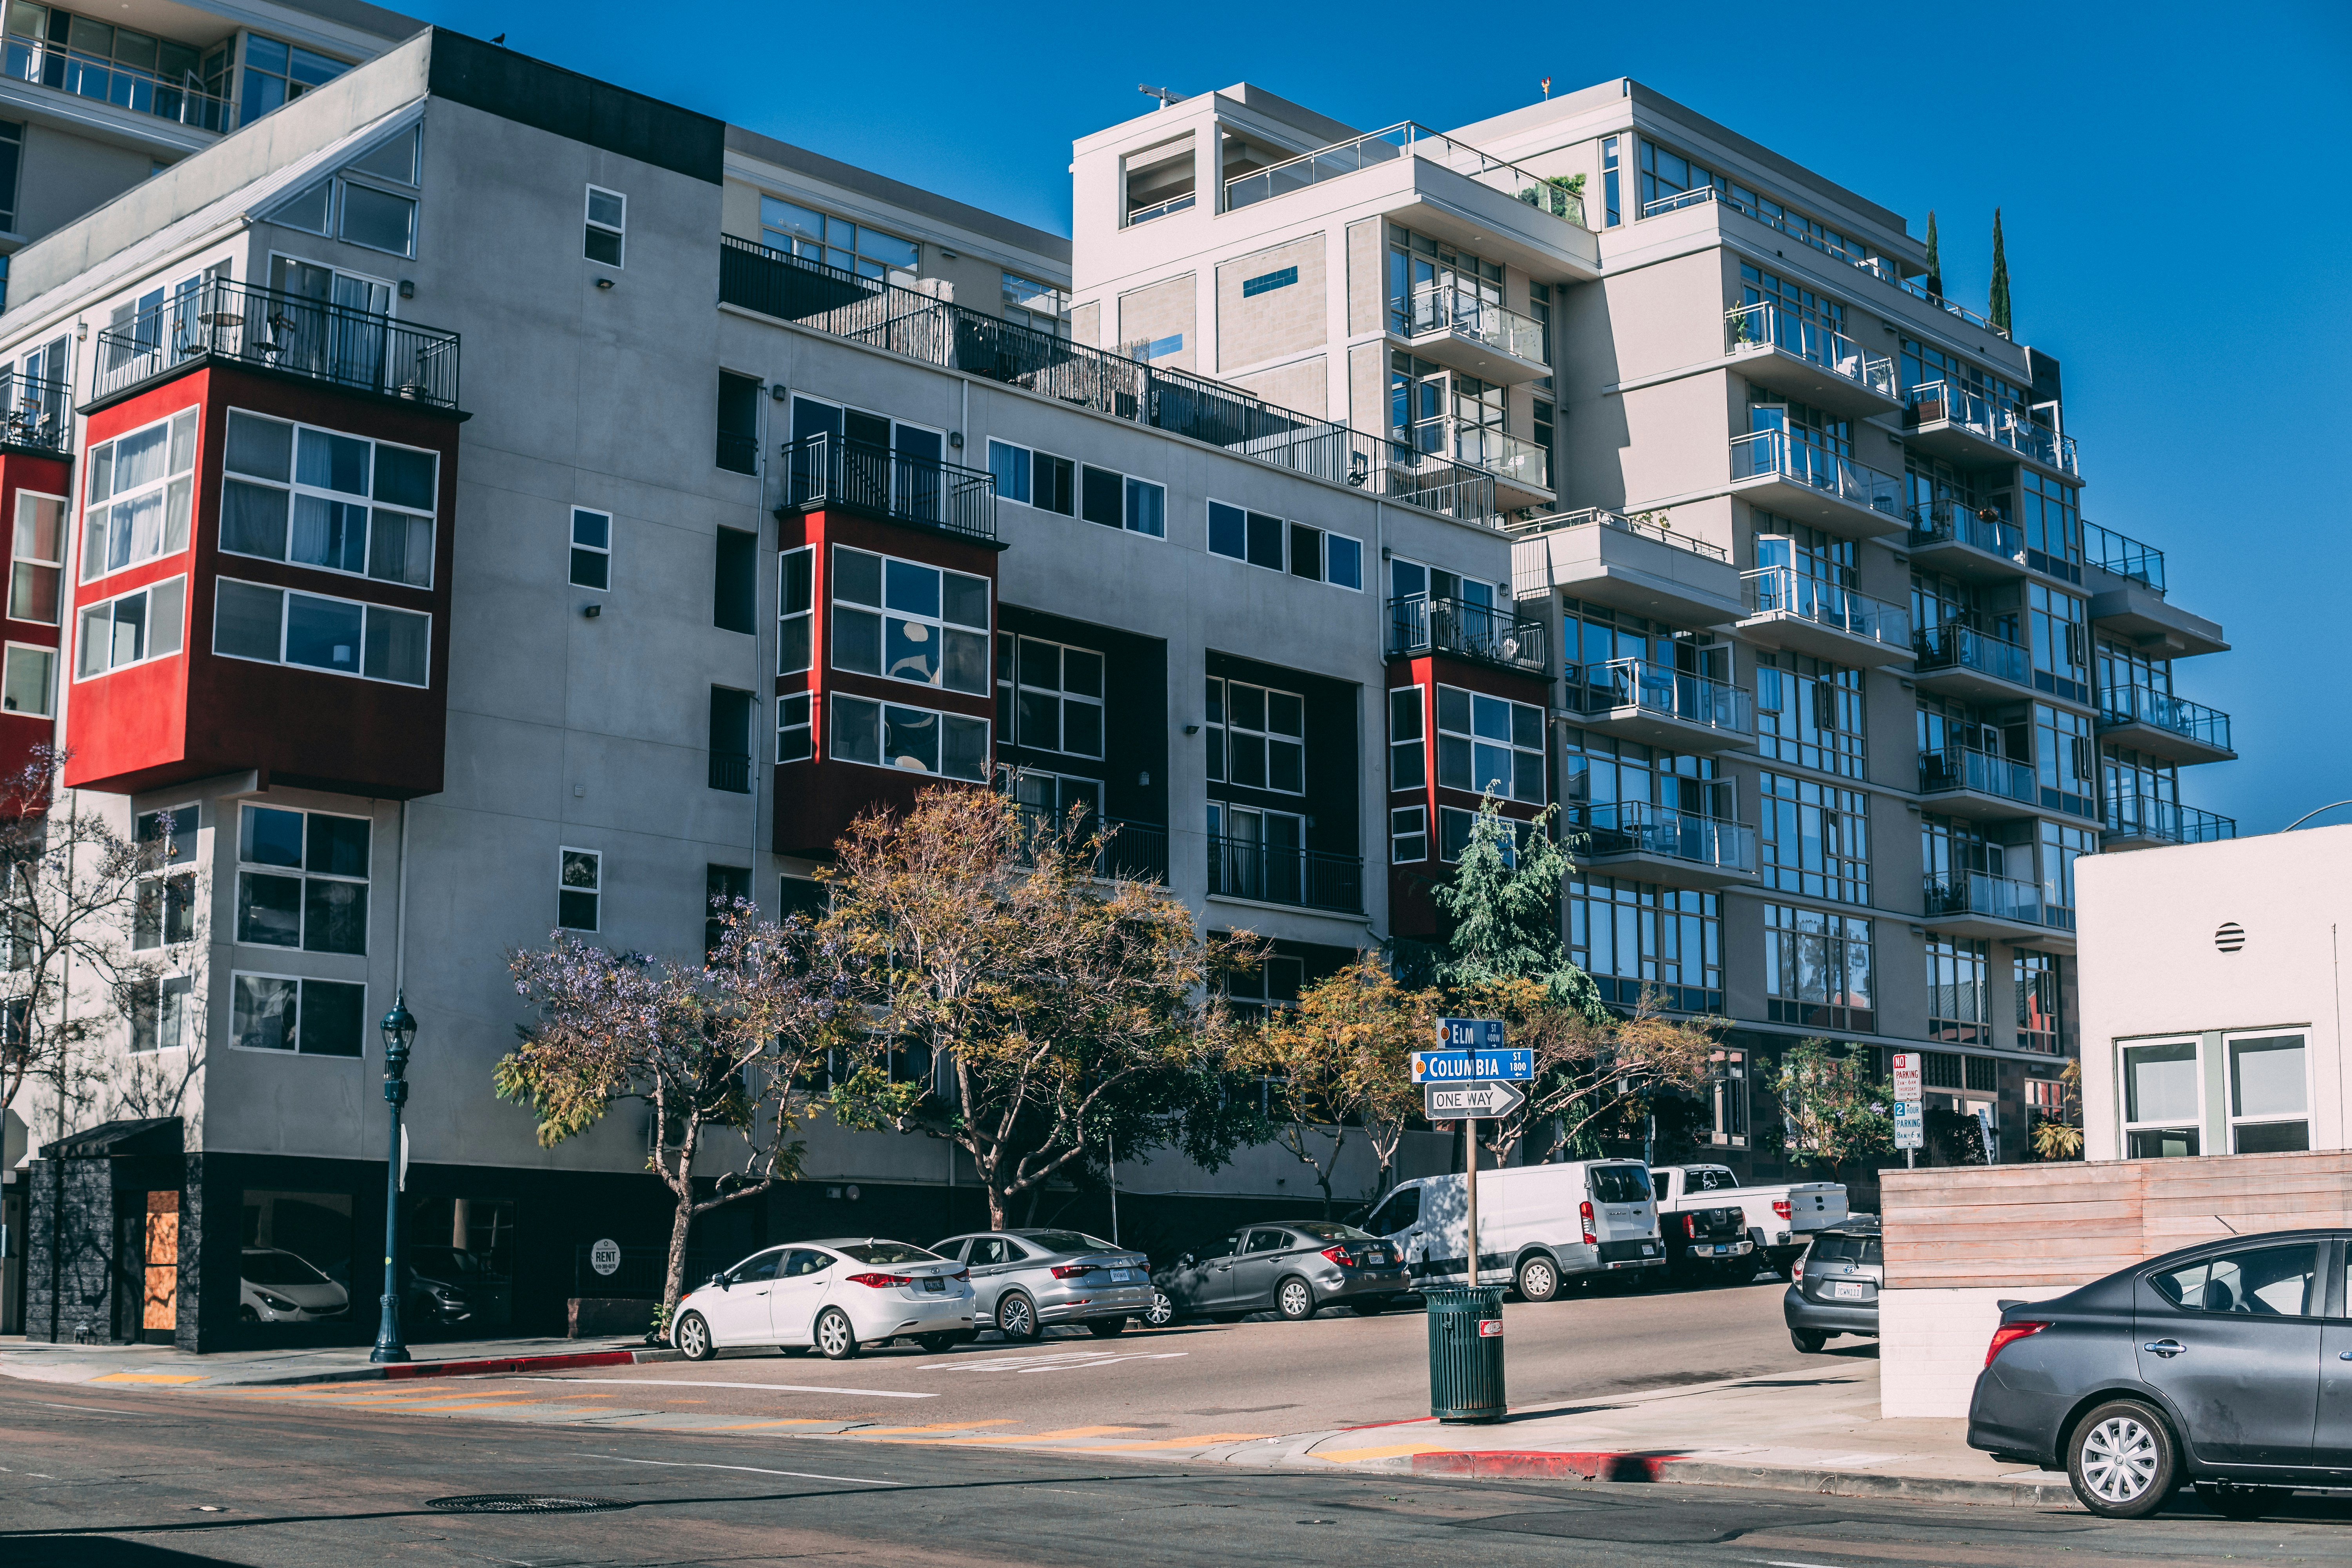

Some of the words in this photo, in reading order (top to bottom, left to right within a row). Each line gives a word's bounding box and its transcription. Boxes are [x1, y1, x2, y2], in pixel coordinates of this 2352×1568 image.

[1453, 1024, 1474, 1044] ELM
[1487, 1034, 1500, 1042] 400W
[1513, 1052, 1522, 1061] ST
[1895, 1056, 1904, 1067] NO
[1430, 1057, 1499, 1077] COLUMBIA
[1510, 1062, 1526, 1071] 1800
[1896, 1070, 1918, 1079] PARKING
[1437, 1093, 1461, 1107] ONE
[1467, 1092, 1494, 1106] WAY
[1896, 1105, 1903, 1115] 2
[1897, 1119, 1920, 1128] PARKING
[596, 1252, 616, 1262] RENT
[1837, 1288, 1860, 1296] 7CWN111
